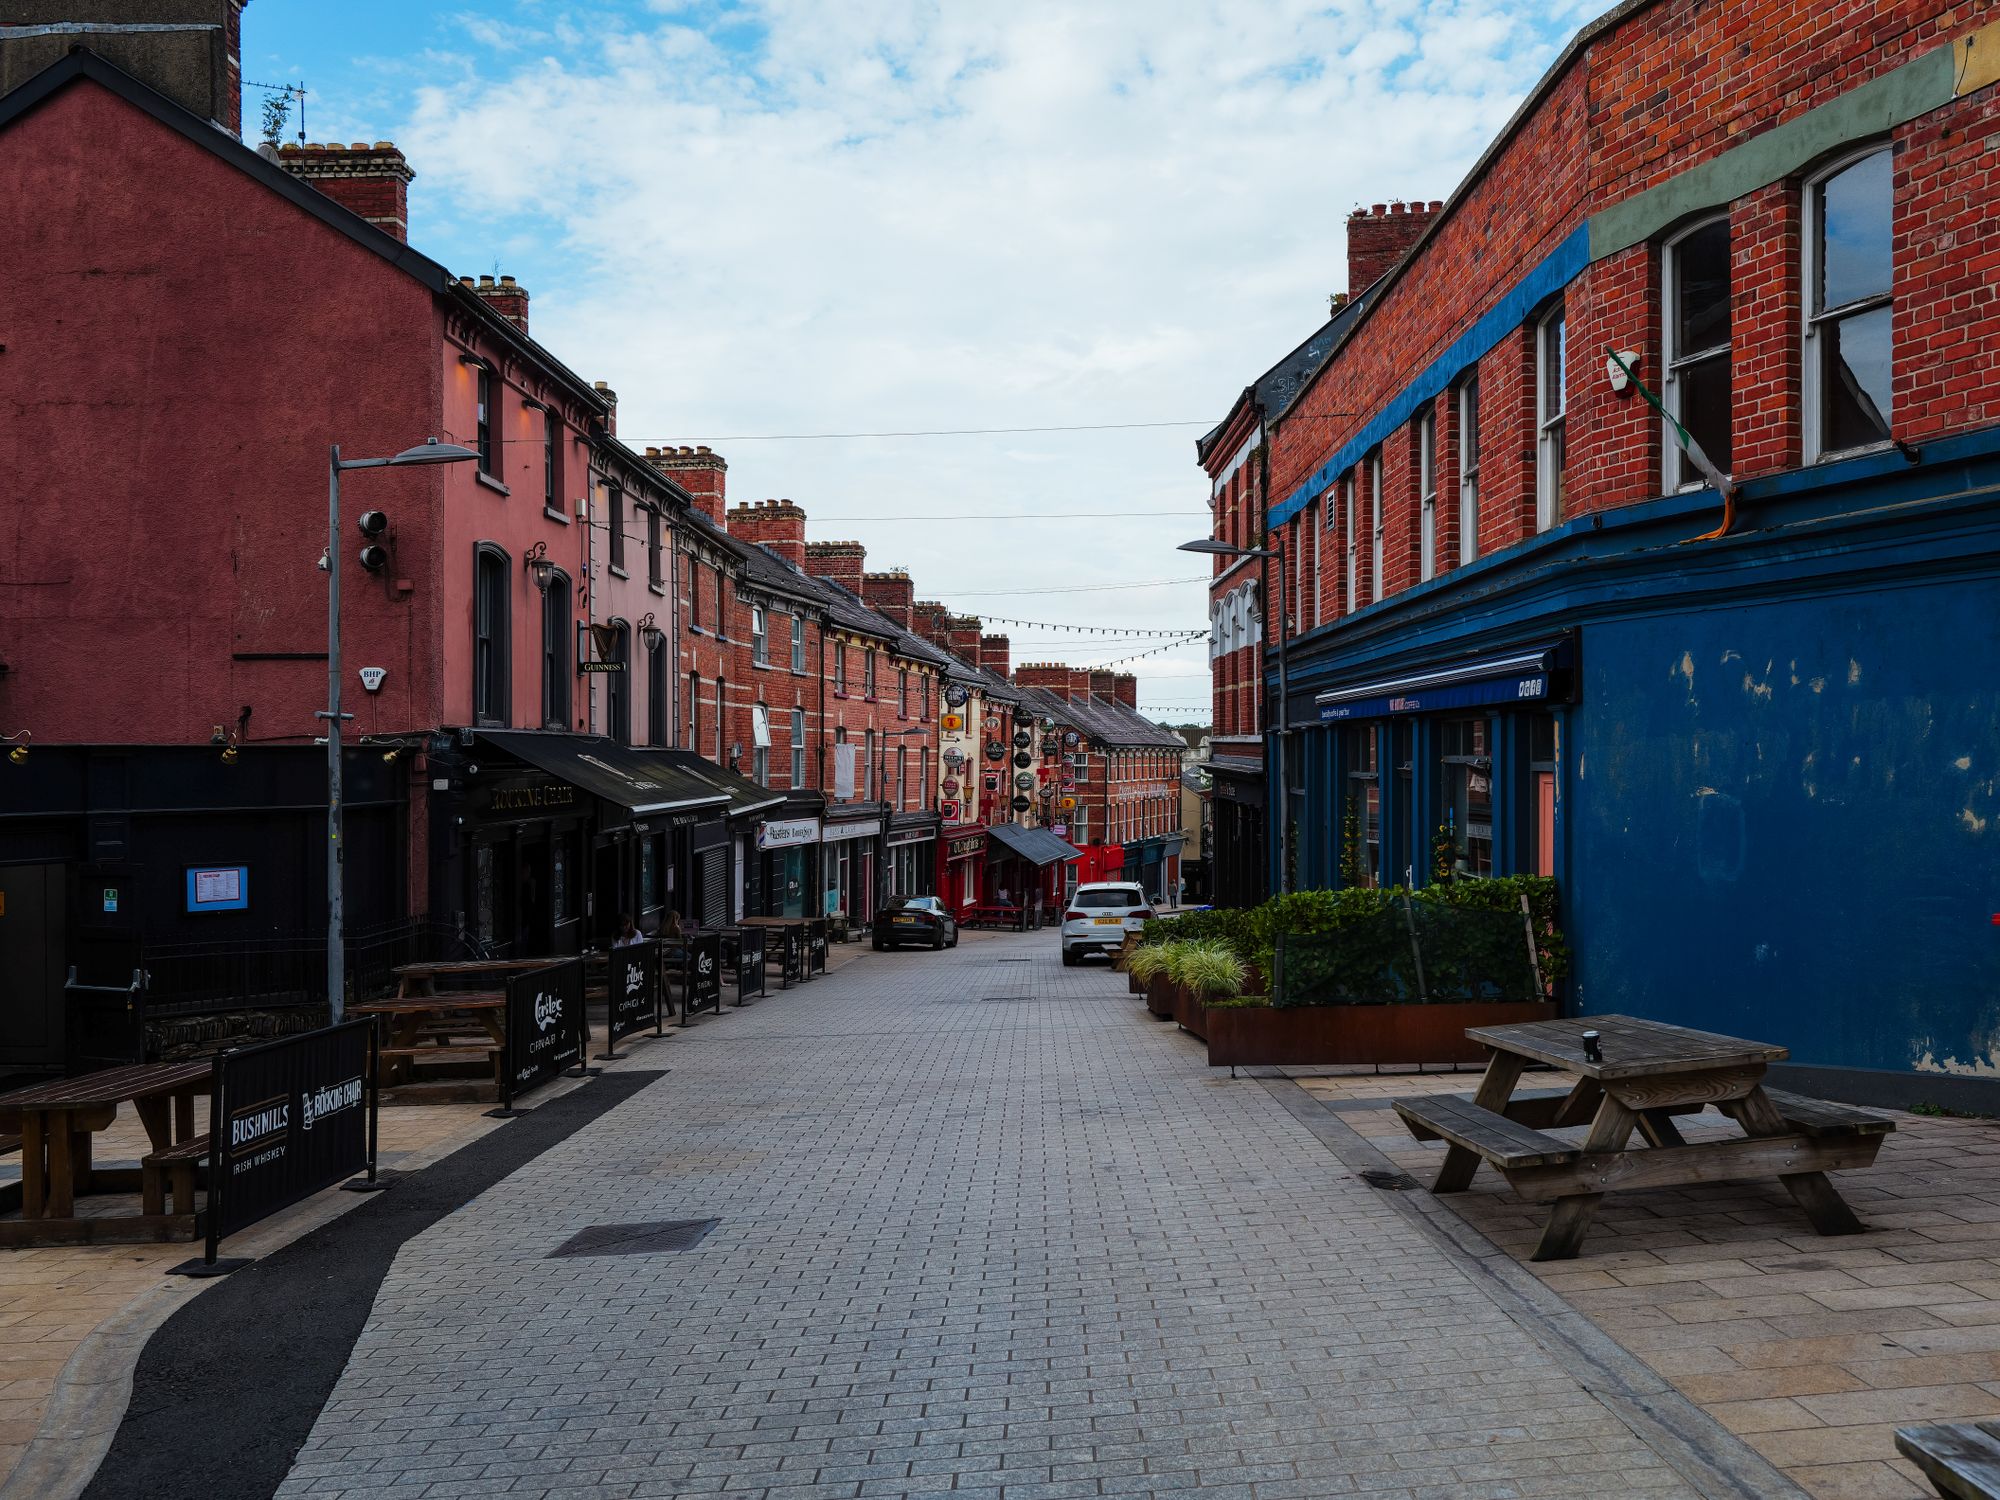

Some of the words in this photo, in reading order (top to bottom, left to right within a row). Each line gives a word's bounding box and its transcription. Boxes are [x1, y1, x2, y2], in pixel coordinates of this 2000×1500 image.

[584, 663, 621, 671] GUINNESS
[314, 1085, 343, 1118] ROCKING
[343, 1079, 363, 1105] CHAIR
[231, 1103, 290, 1147] BUSHMILLS
[233, 1159, 253, 1176] IRISH
[254, 1145, 287, 1167] WHISKEY
